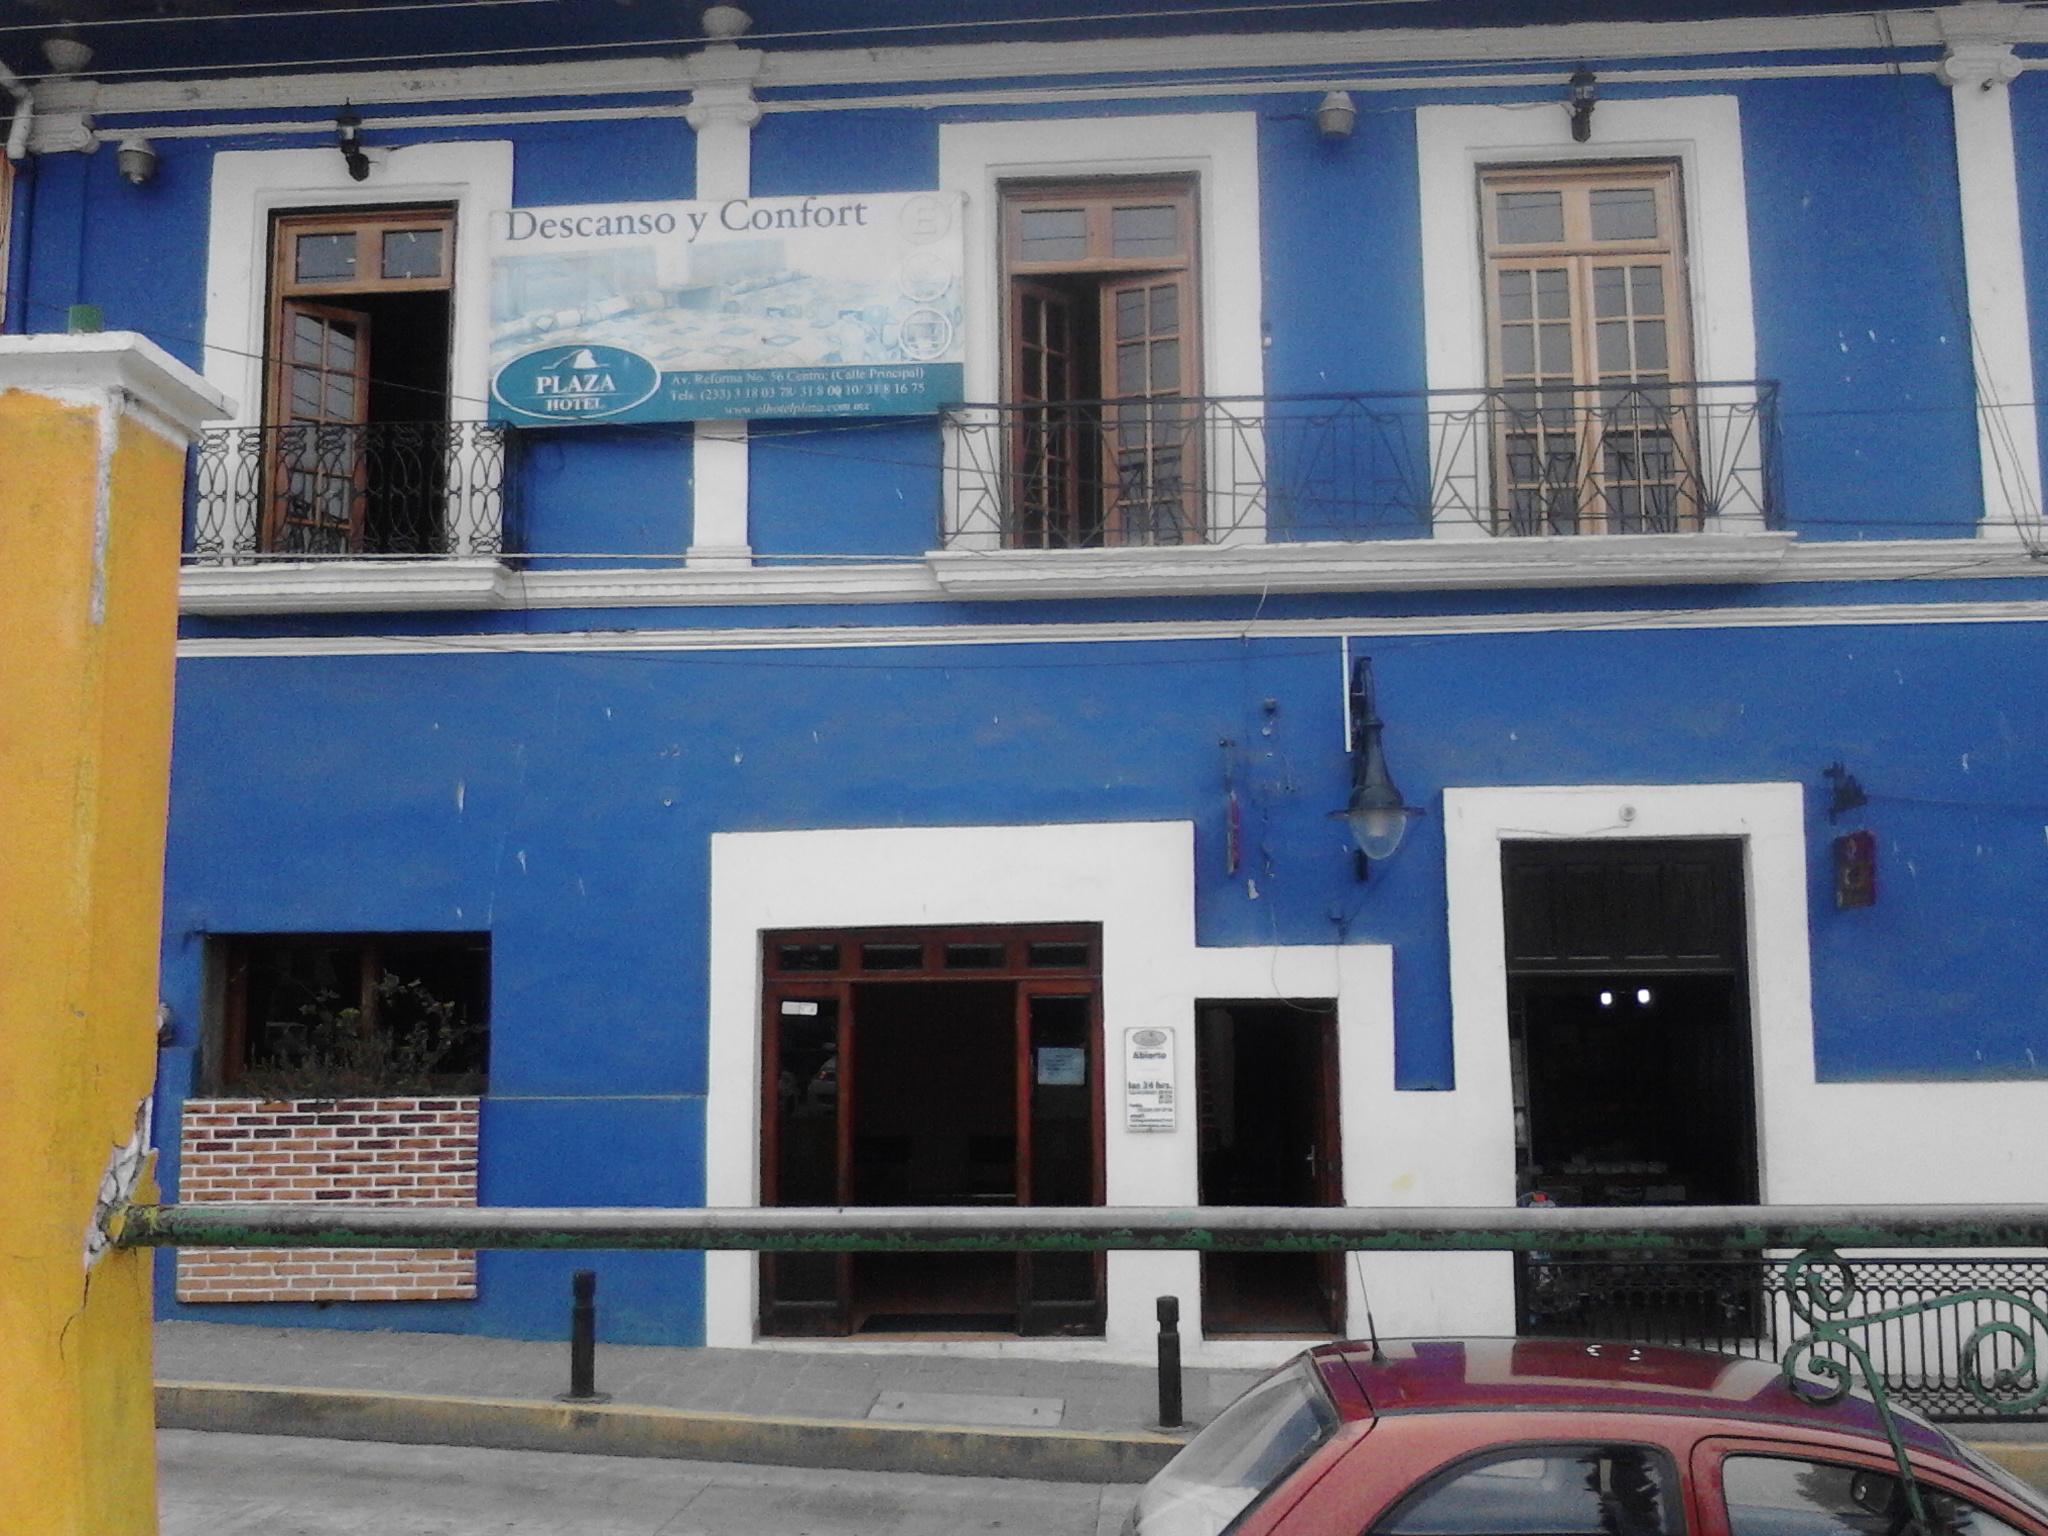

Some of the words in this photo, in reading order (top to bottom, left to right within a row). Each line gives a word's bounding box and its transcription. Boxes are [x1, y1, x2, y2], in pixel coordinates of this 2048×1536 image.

[506, 210, 676, 241] Descanso
[687, 211, 709, 243] y
[719, 198, 869, 232] Confort
[535, 374, 617, 395] PLAZA
[694, 374, 743, 385] Reforma
[546, 398, 605, 411] HOTEL
